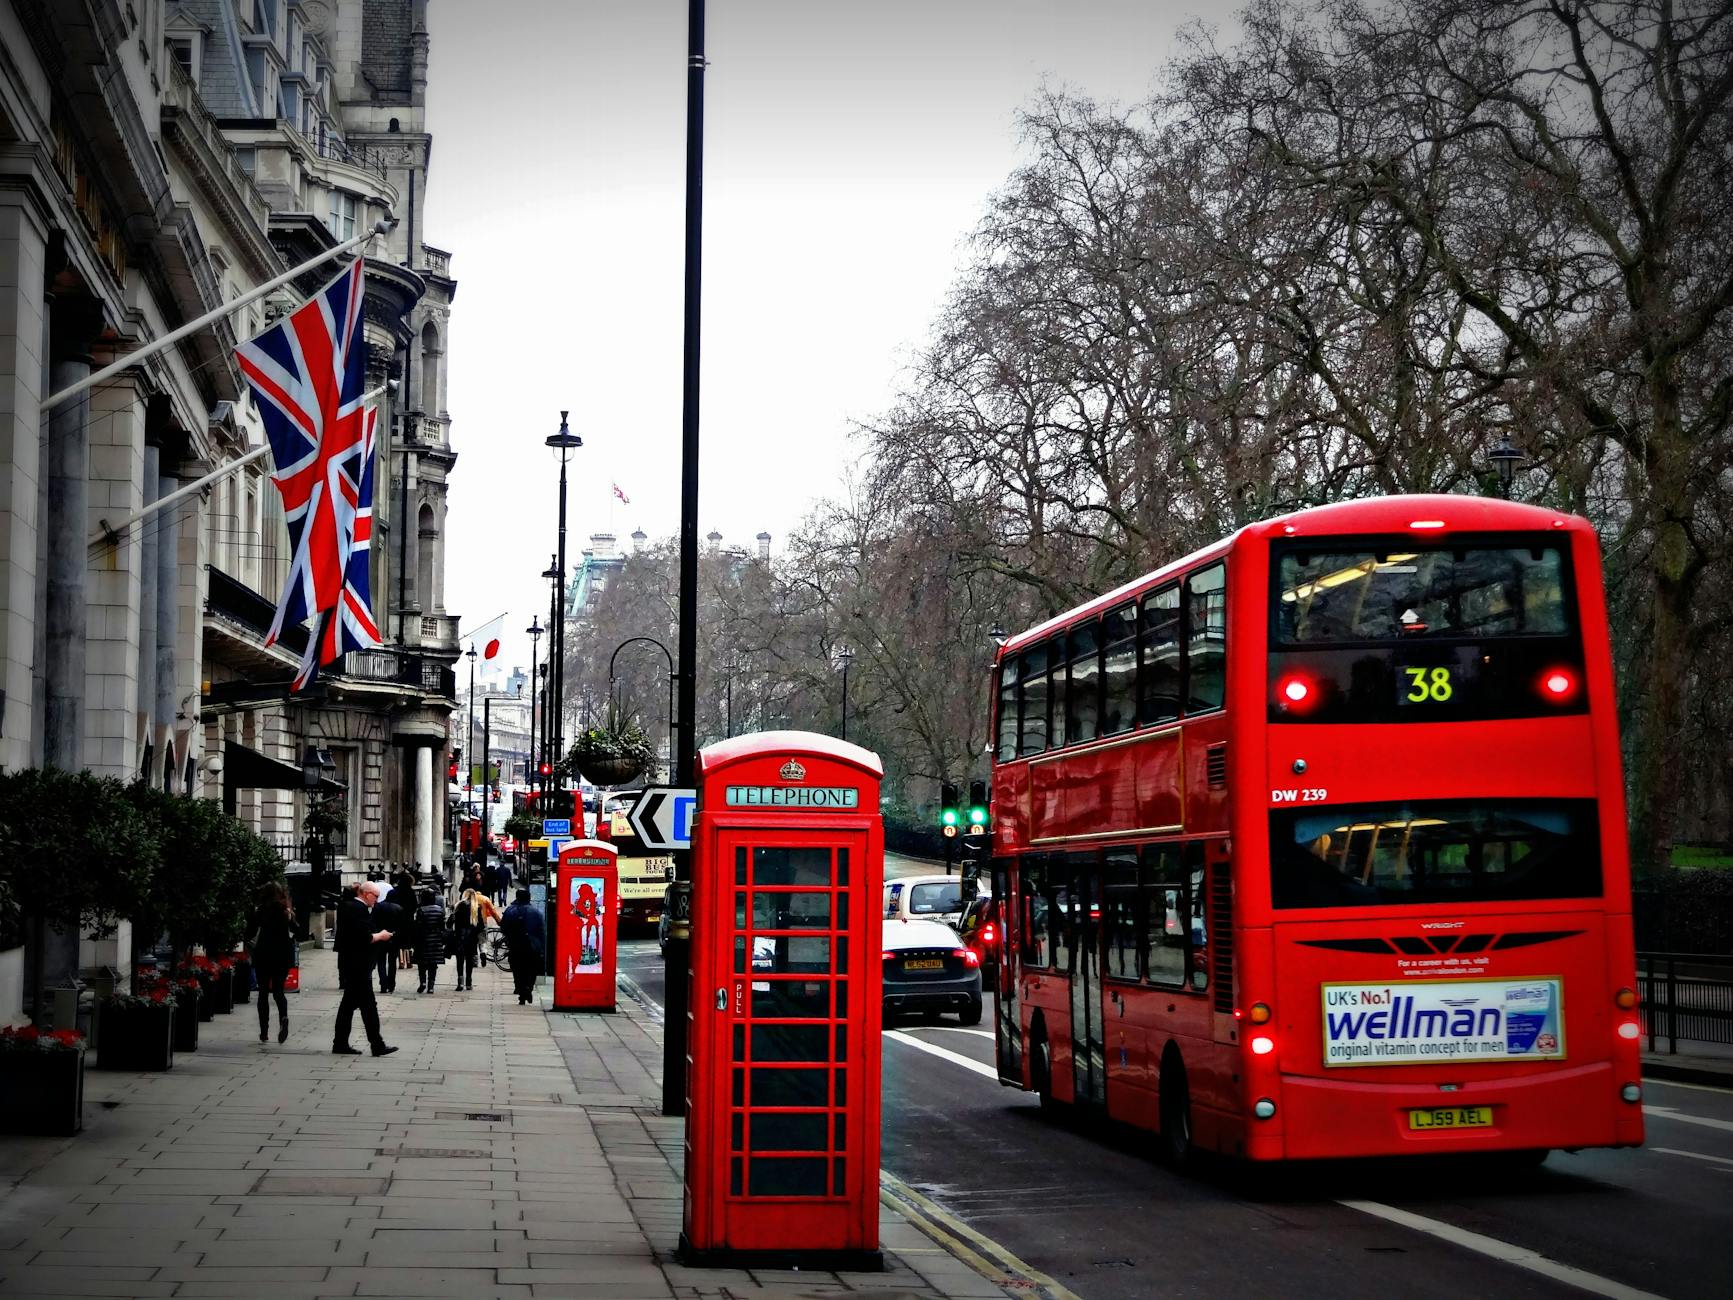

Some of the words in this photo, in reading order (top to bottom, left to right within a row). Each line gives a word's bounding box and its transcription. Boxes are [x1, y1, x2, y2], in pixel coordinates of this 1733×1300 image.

[1405, 667, 1452, 702] 38
[733, 787, 853, 806] TELEPHONE
[1272, 789, 1298, 802] DW
[1302, 788, 1328, 801] 239
[1398, 959, 1410, 967] For
[1328, 991, 1358, 1006] UK's
[1361, 989, 1391, 1005] No.1
[1327, 996, 1500, 1040] wellman
[1330, 1041, 1373, 1060] original
[1375, 1041, 1417, 1056] vitamin
[1420, 1041, 1460, 1057] concept
[1462, 1038, 1479, 1053] for
[1481, 1041, 1505, 1053] men
[1415, 1111, 1454, 1127] LJ59
[1459, 1109, 1487, 1124] AEL
